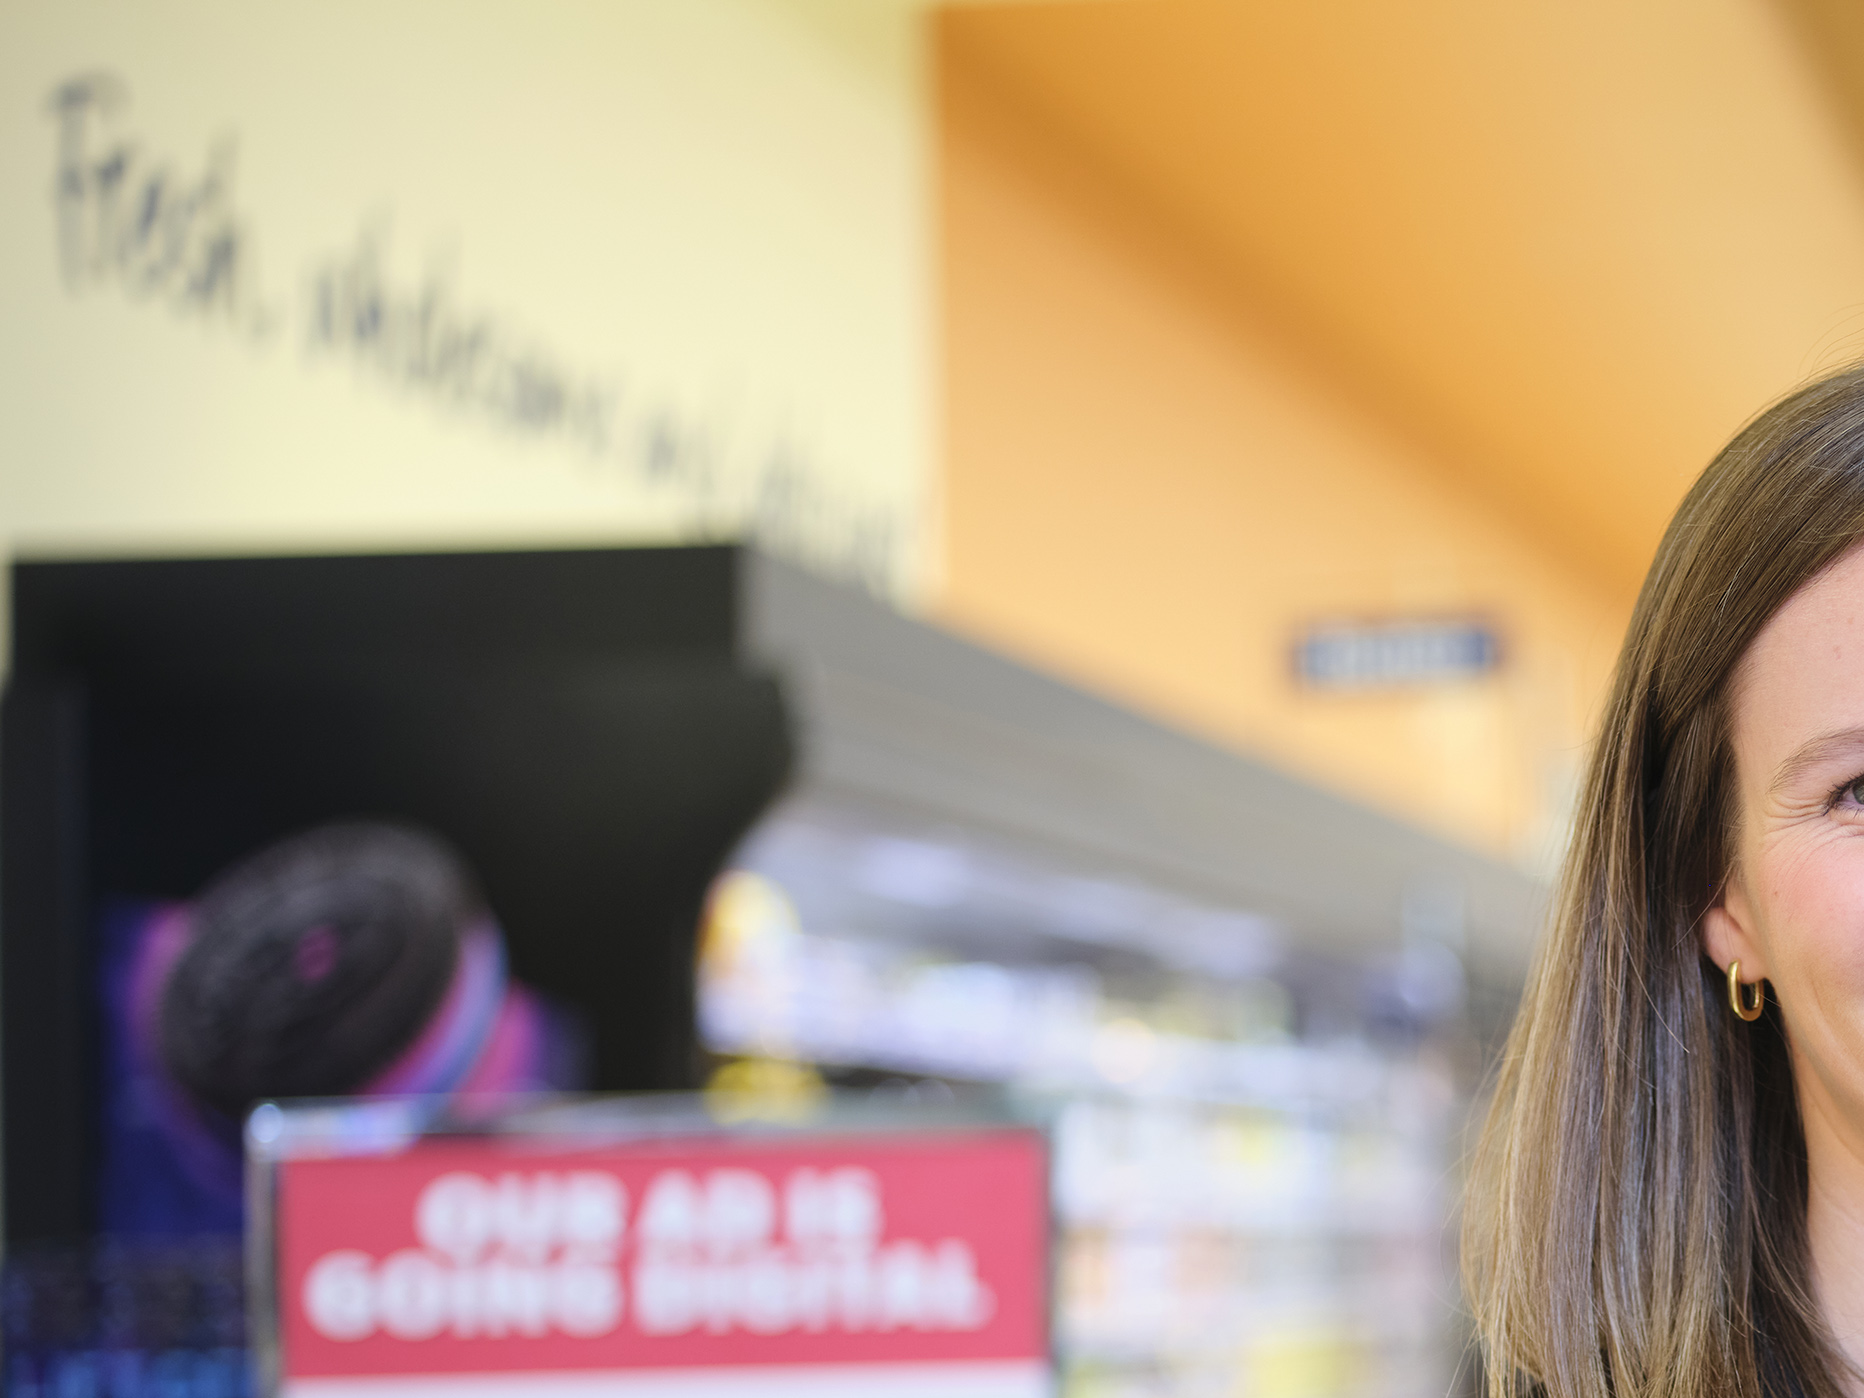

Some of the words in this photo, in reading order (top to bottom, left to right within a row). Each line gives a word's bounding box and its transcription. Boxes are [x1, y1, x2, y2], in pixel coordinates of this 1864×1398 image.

[414, 1170, 630, 1258] OUR
[636, 1167, 778, 1256] AD
[784, 1164, 884, 1252] IS
[304, 1248, 626, 1341] GOING
[632, 1238, 995, 1336] DIGITAL
